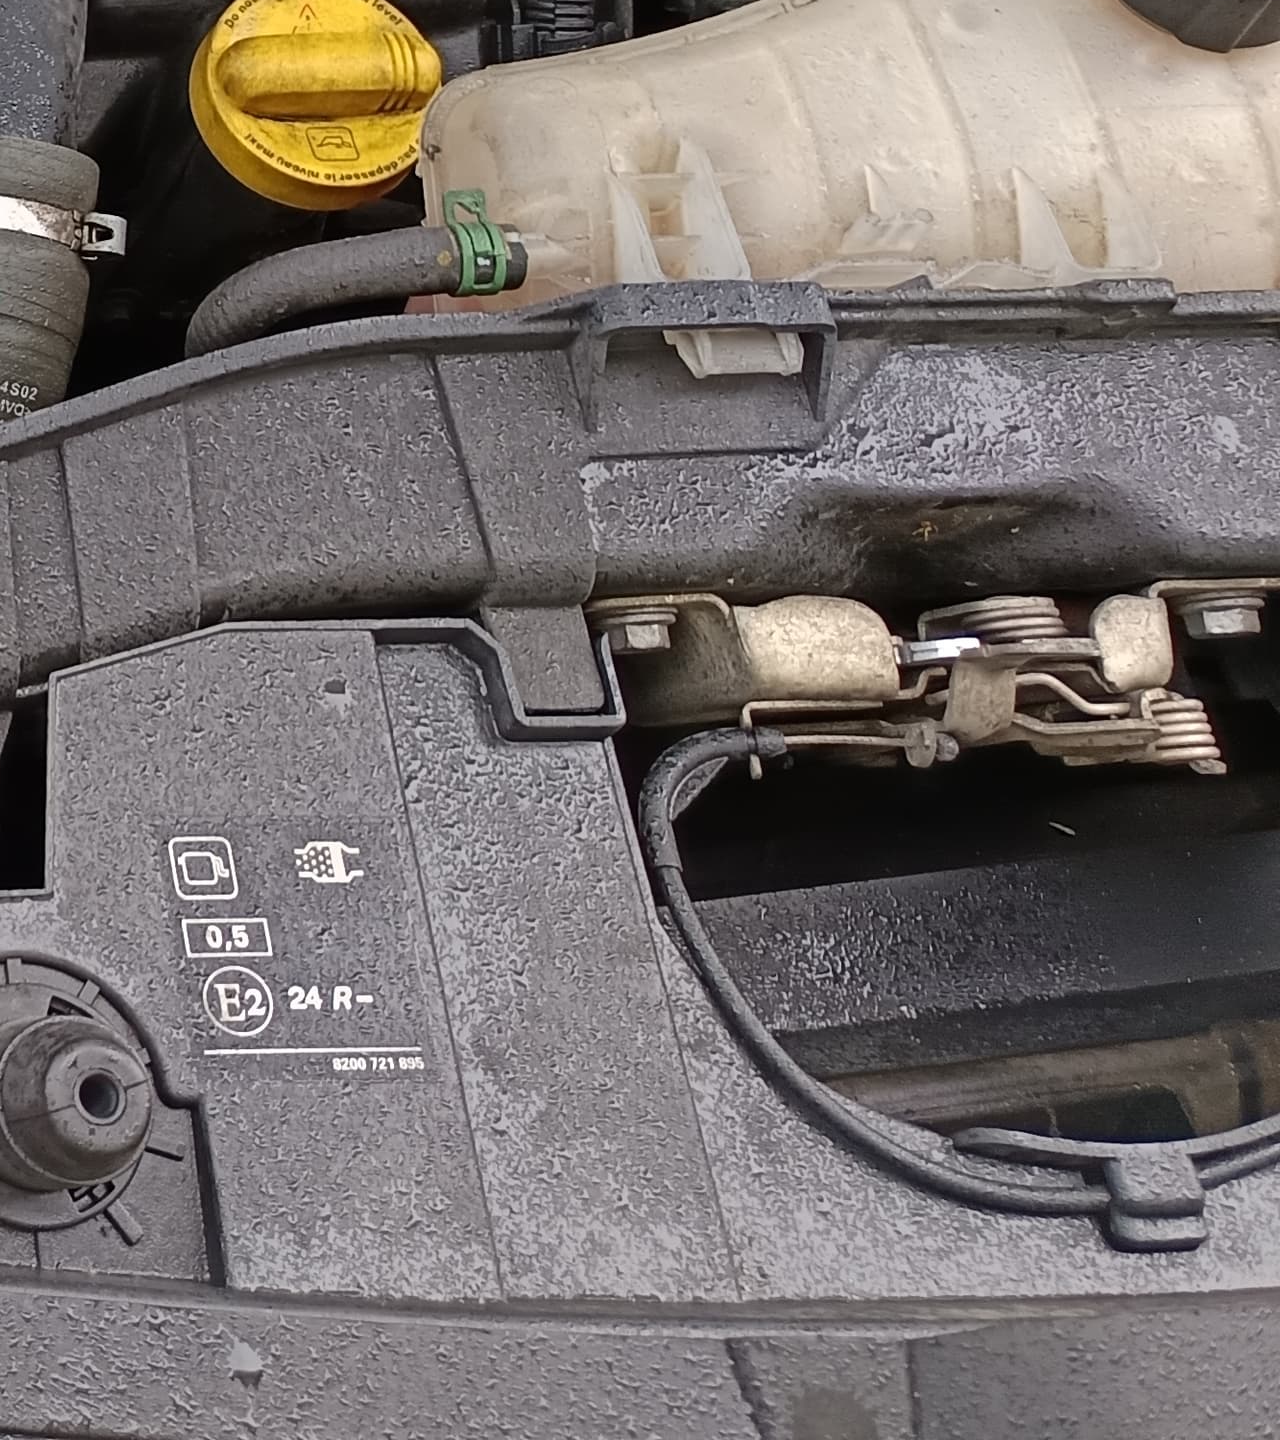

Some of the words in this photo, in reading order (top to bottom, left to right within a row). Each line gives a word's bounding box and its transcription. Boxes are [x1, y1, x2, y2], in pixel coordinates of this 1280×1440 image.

[224, 14, 240, 28] Do
[245, 133, 275, 158] maxi
[276, 156, 320, 179] niveau
[324, 172, 336, 182] le
[205, 925, 249, 952] 0,5
[214, 983, 266, 1022] E2
[288, 986, 322, 1009] 24
[332, 1058, 367, 1071] 8200
[371, 1058, 395, 1071] 721
